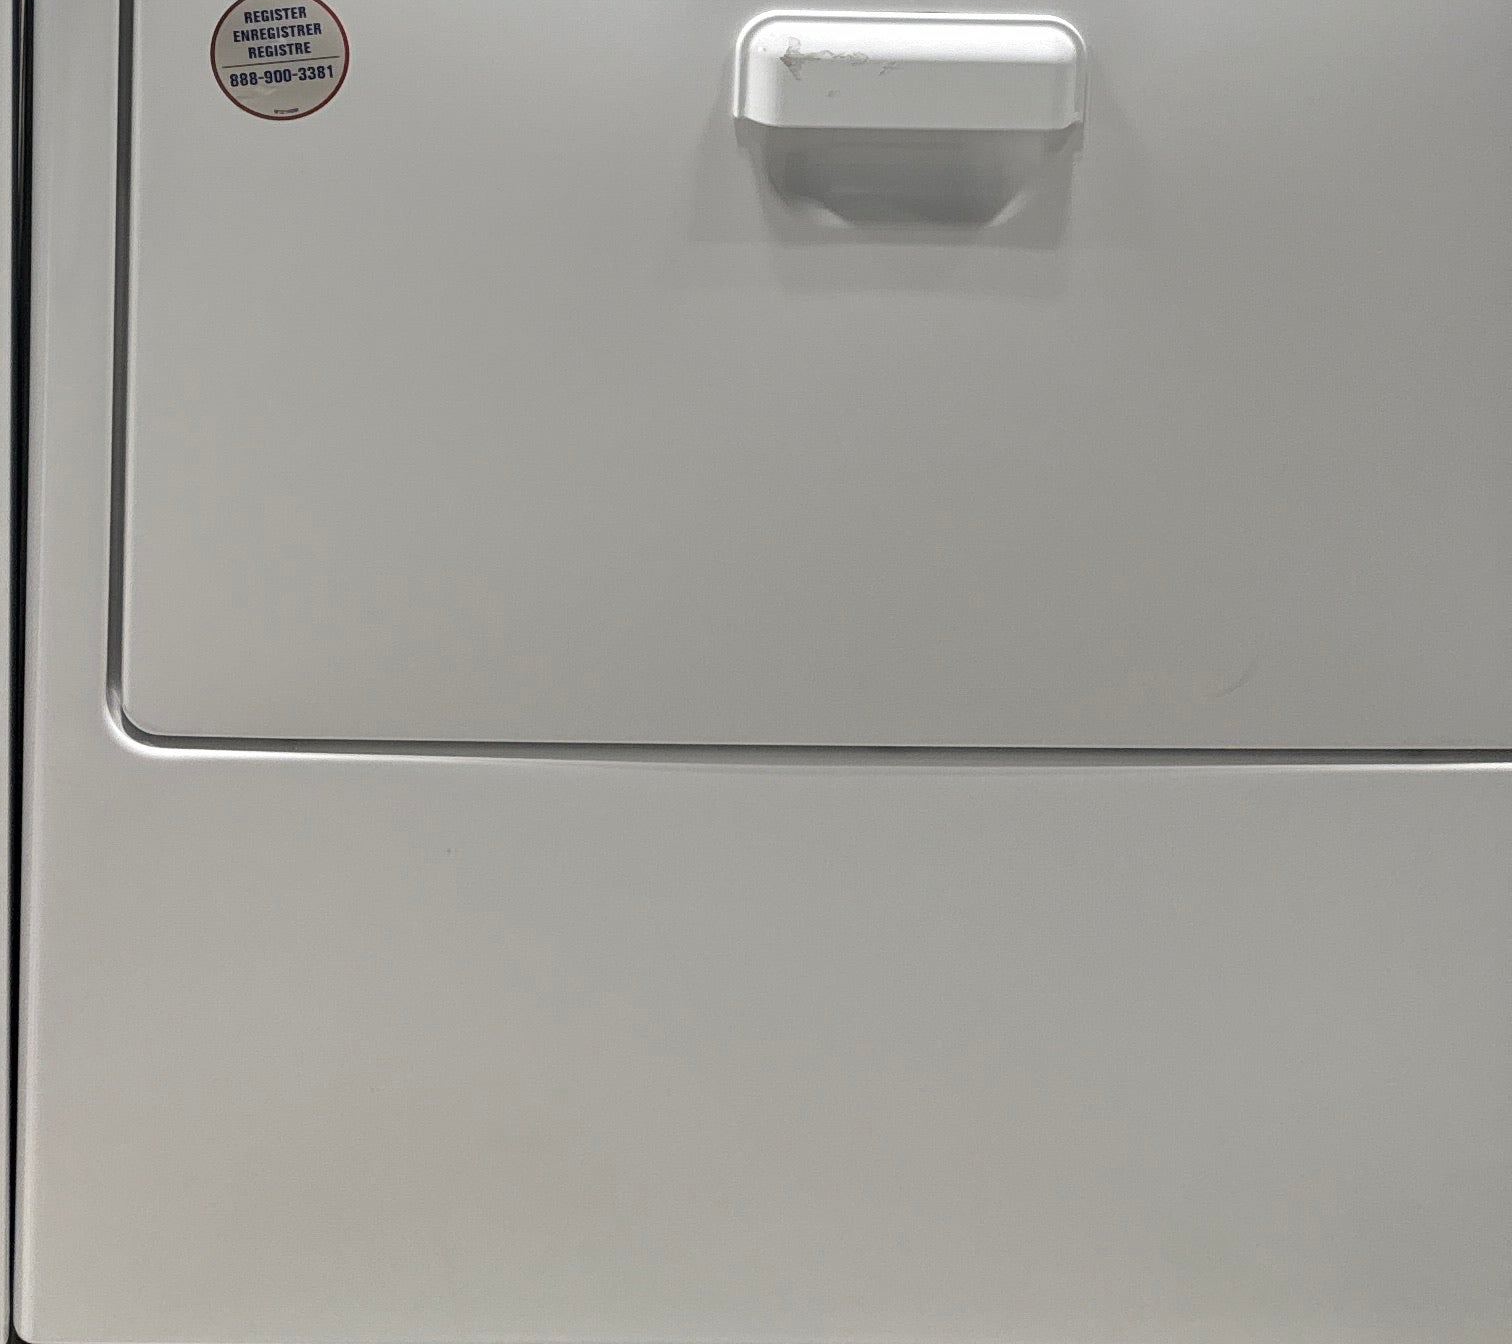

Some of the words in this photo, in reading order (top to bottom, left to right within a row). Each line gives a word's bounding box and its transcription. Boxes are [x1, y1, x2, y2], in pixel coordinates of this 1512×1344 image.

[244, 6, 307, 24] REGISTER
[233, 22, 322, 43] ENREGISTRER
[248, 41, 312, 59] REGISTRE
[230, 65, 334, 87] 888-900-3381
